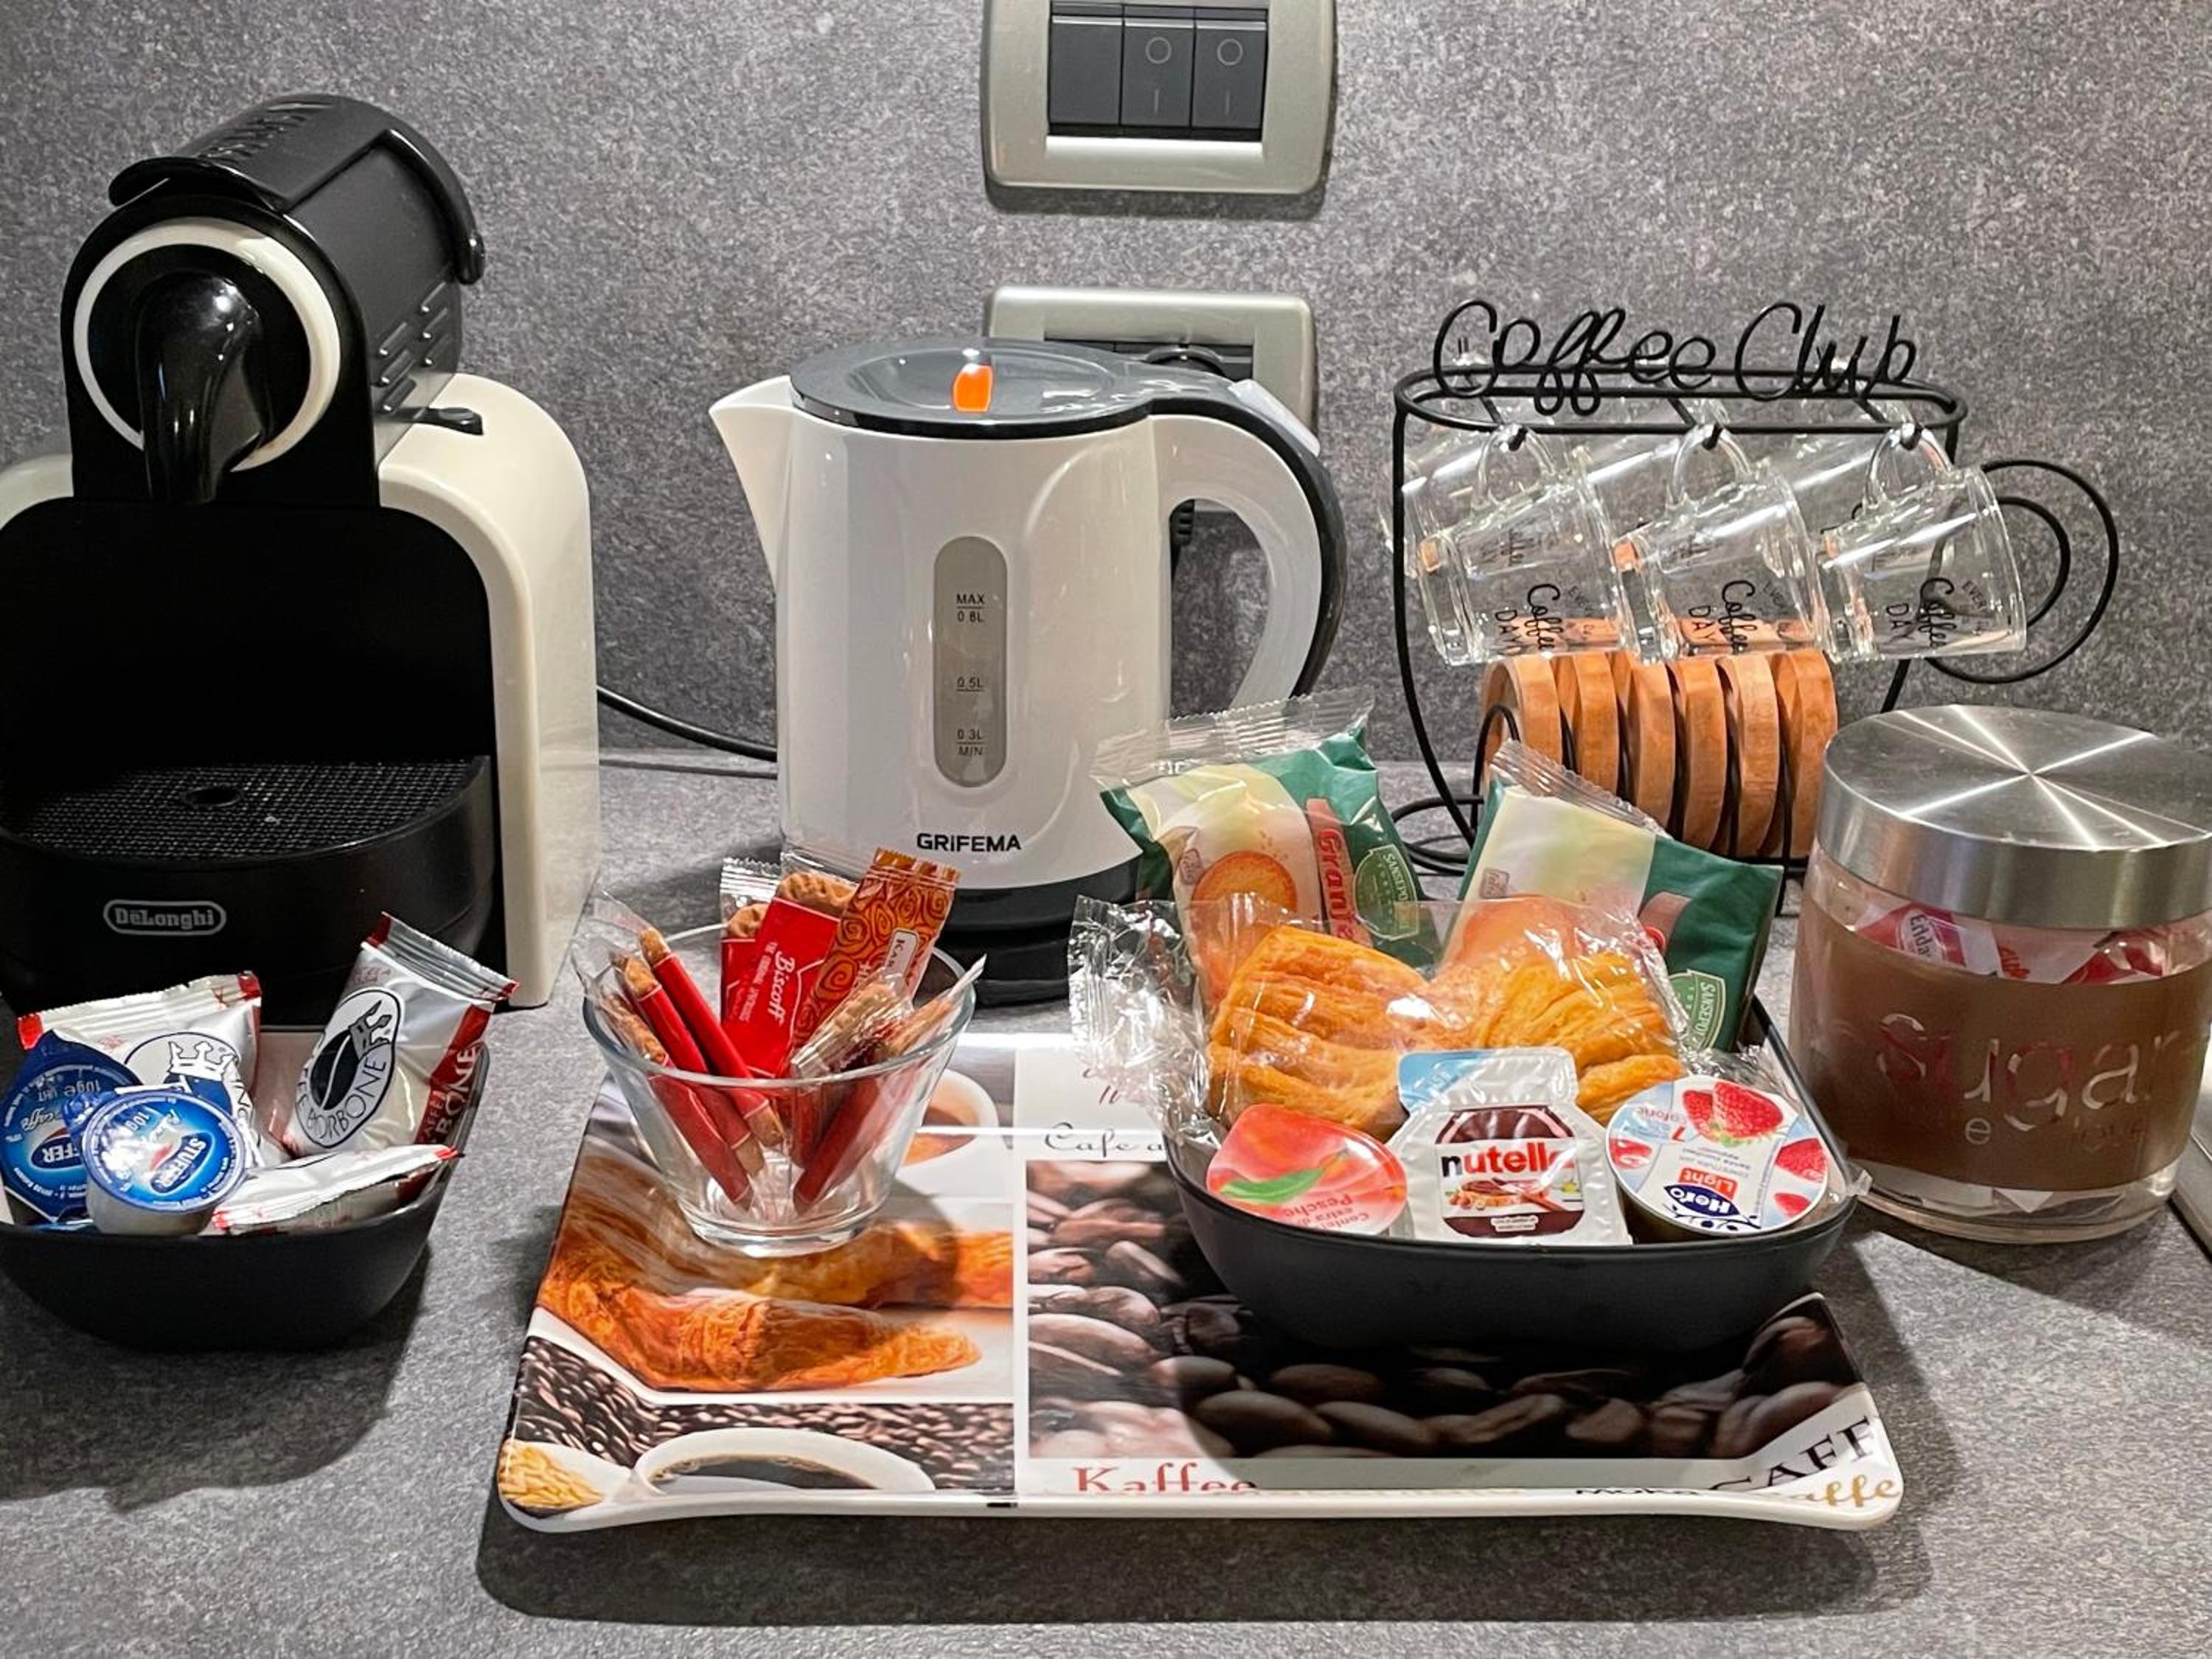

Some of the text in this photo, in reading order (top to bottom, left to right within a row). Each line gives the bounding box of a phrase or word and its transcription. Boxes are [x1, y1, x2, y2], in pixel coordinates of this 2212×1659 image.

[1433, 299, 1916, 415] Coffee Club
[956, 593, 985, 605] MAX
[1524, 582, 1564, 650] Coffee
[1718, 580, 1758, 649] Coffee
[1917, 577, 1958, 647] Coffee
[1688, 605, 1718, 643] DAY
[1886, 602, 1916, 644] DAY
[957, 745, 984, 756] MIN
[917, 832, 1022, 852] GRIFEMA
[768, 950, 795, 1026] Biscoff
[307, 1058, 387, 1140] BORBONE
[1670, 1185, 1731, 1214] Hero
[1682, 1169, 1733, 1194] Light
[1073, 1462, 1259, 1495] Kaffee
